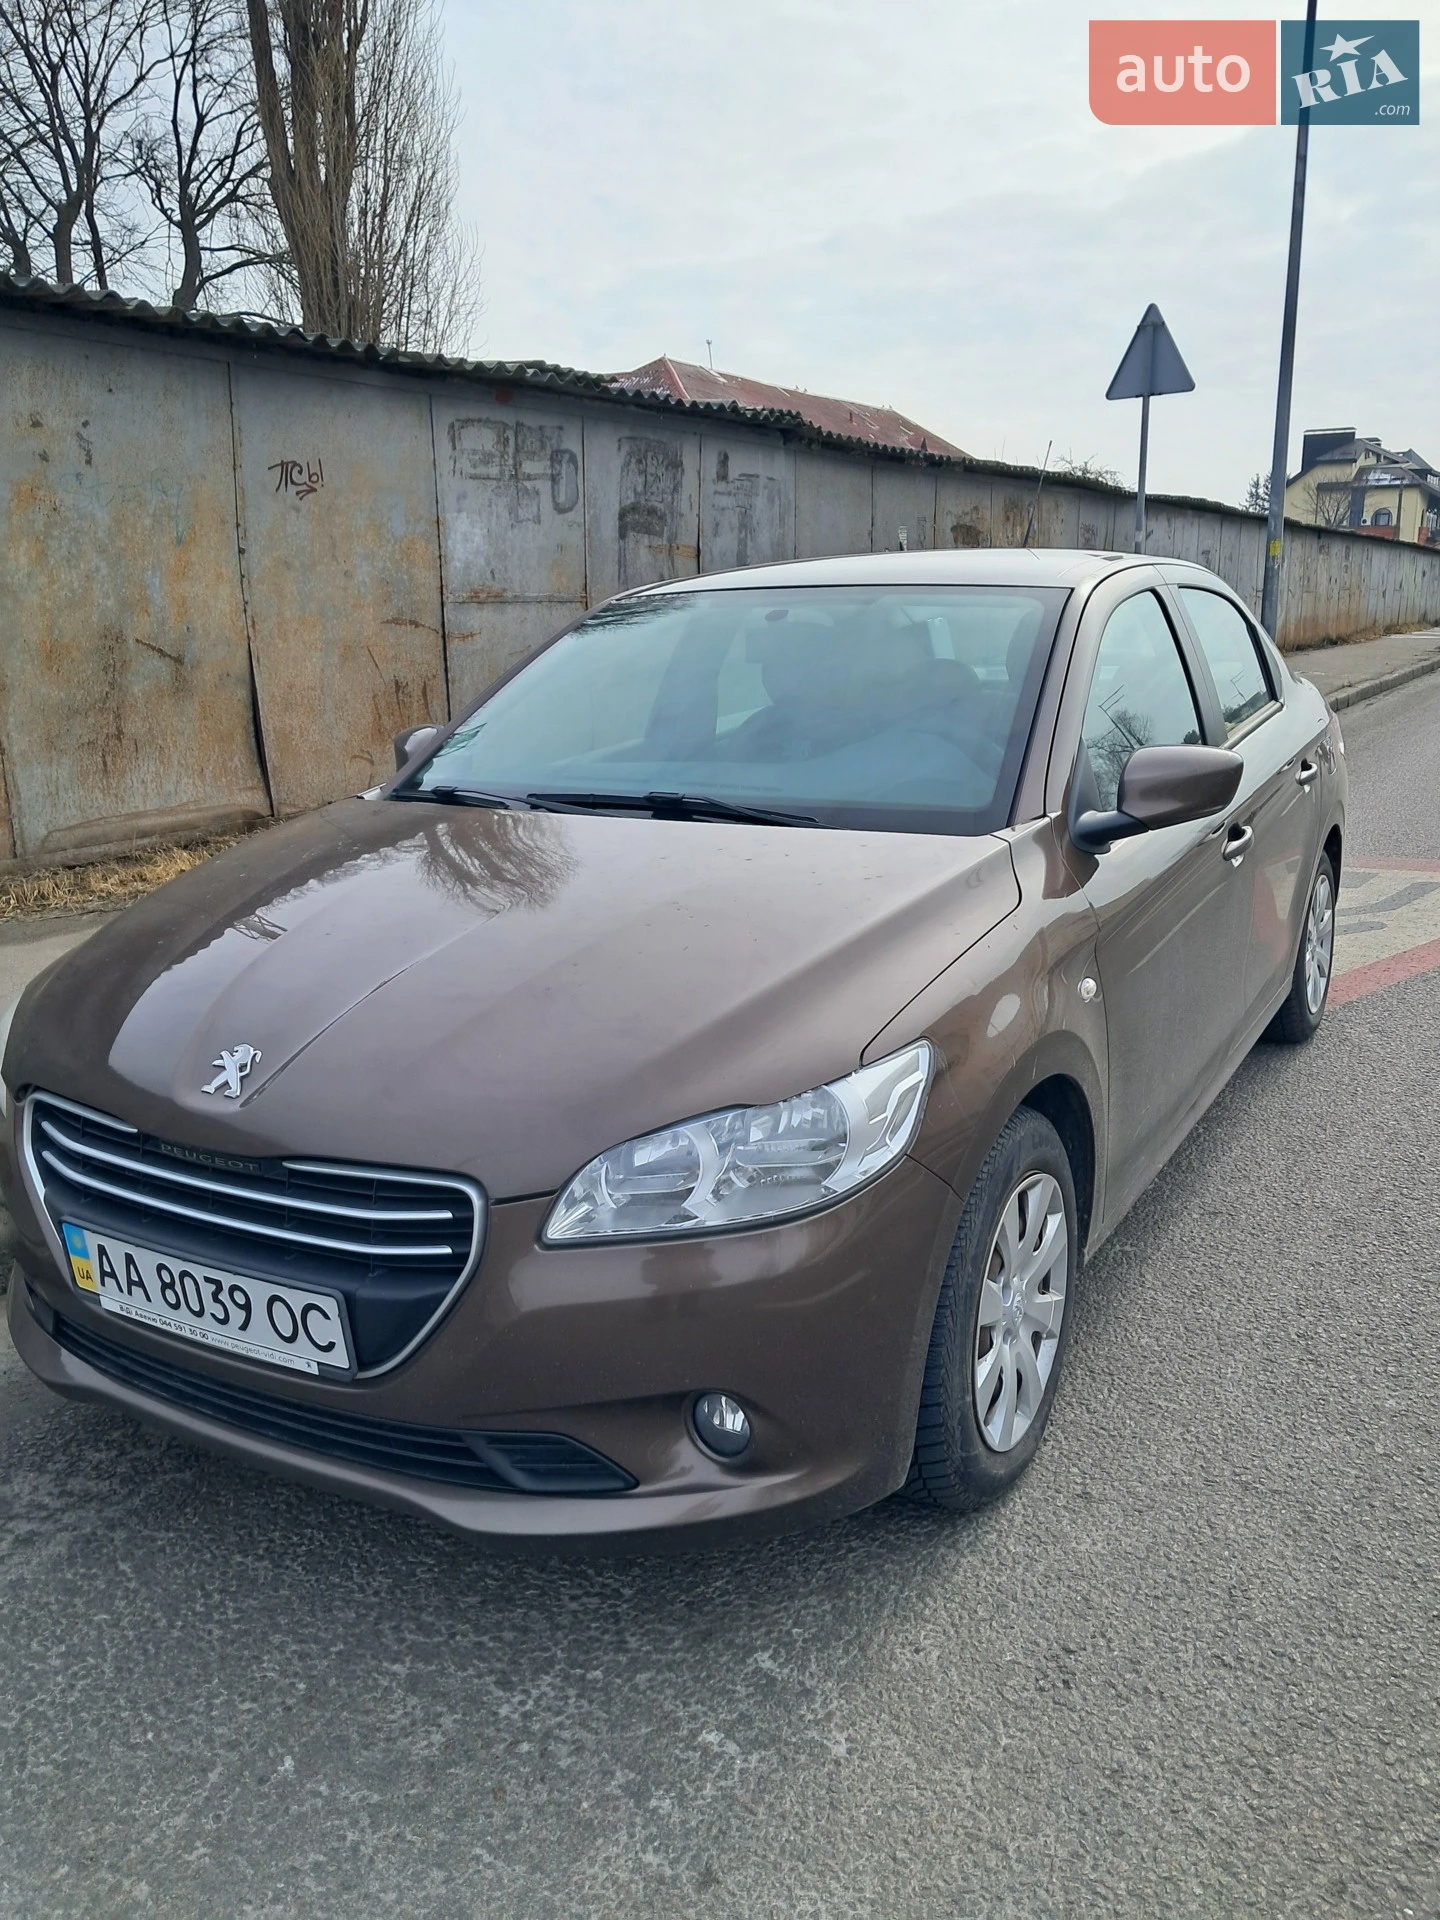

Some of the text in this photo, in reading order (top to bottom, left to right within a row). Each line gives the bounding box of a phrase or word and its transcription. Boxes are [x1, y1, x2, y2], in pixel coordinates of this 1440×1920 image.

[161, 1143, 259, 1172] PEUGEOT
[77, 1265, 95, 1283] UA
[97, 1243, 336, 1353] AA 8039 OC
[159, 1319, 173, 1329] 044
[174, 1323, 187, 1333] 591
[188, 1327, 198, 1337] 30
[199, 1331, 209, 1340] 00
